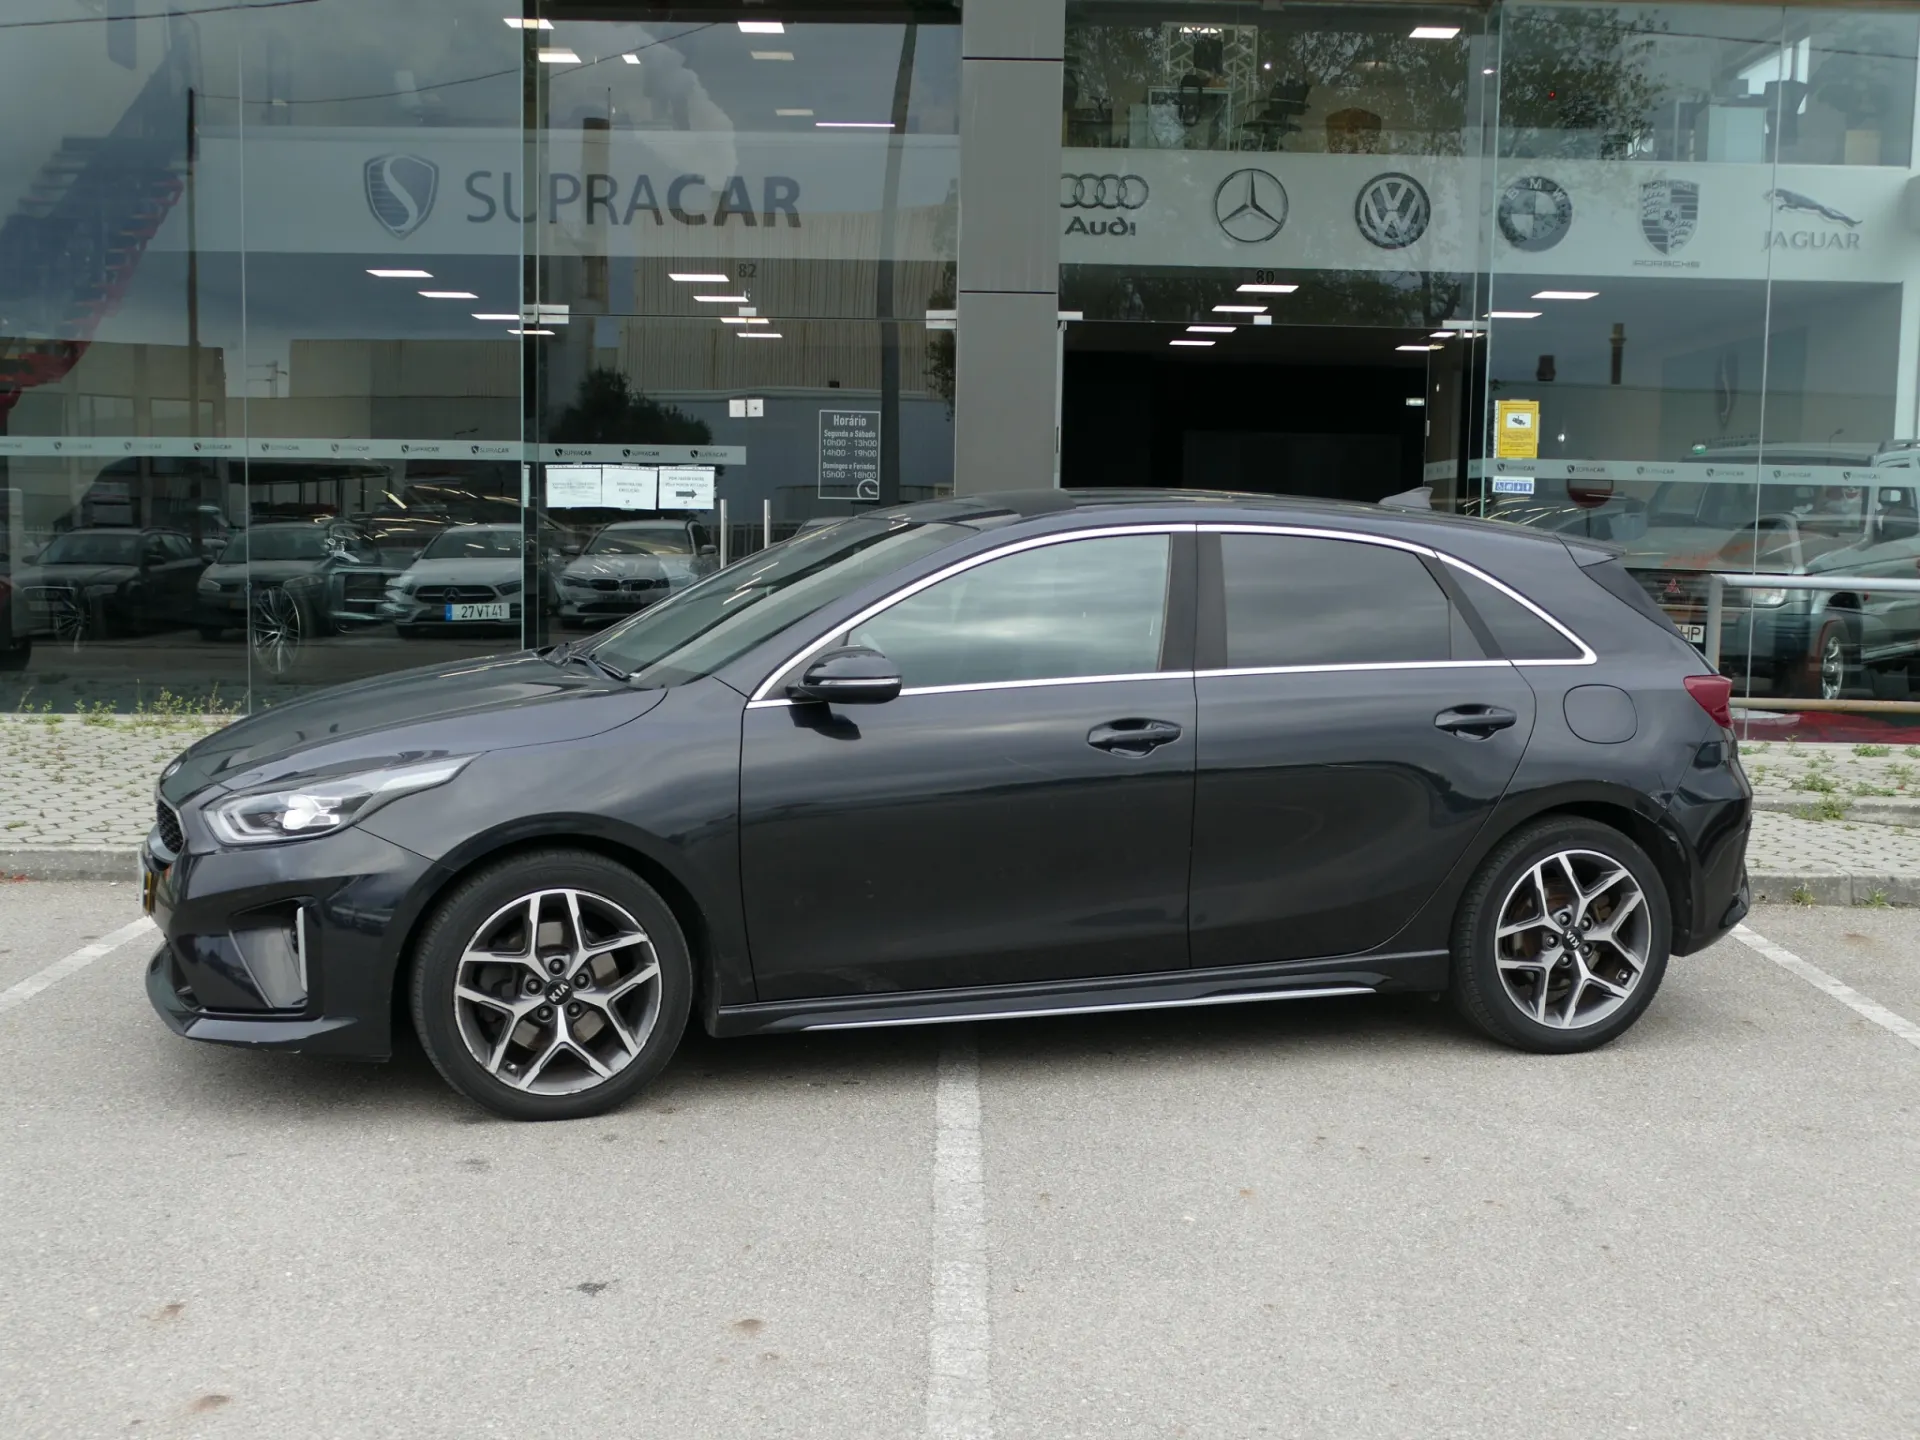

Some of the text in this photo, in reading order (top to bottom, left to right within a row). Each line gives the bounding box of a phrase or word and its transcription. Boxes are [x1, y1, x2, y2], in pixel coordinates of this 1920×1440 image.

[464, 169, 802, 228] SUPRACAR
[1064, 216, 1136, 237] Audi
[1761, 231, 1861, 252] JAGUAR
[1633, 259, 1700, 269] PORSCHE
[738, 263, 758, 279] 82
[1255, 270, 1275, 284] 80
[833, 414, 867, 426] Horário
[823, 429, 848, 438] Segunda
[854, 430, 876, 438] Sábado
[823, 439, 846, 447] 10h00
[854, 439, 878, 447] 13h00
[822, 449, 846, 457] 14h00
[854, 449, 877, 457] 19h00
[822, 461, 848, 470] Domingos
[853, 462, 876, 470] Feriados
[853, 471, 877, 479] 18h00
[548, 983, 569, 1003] KIA
